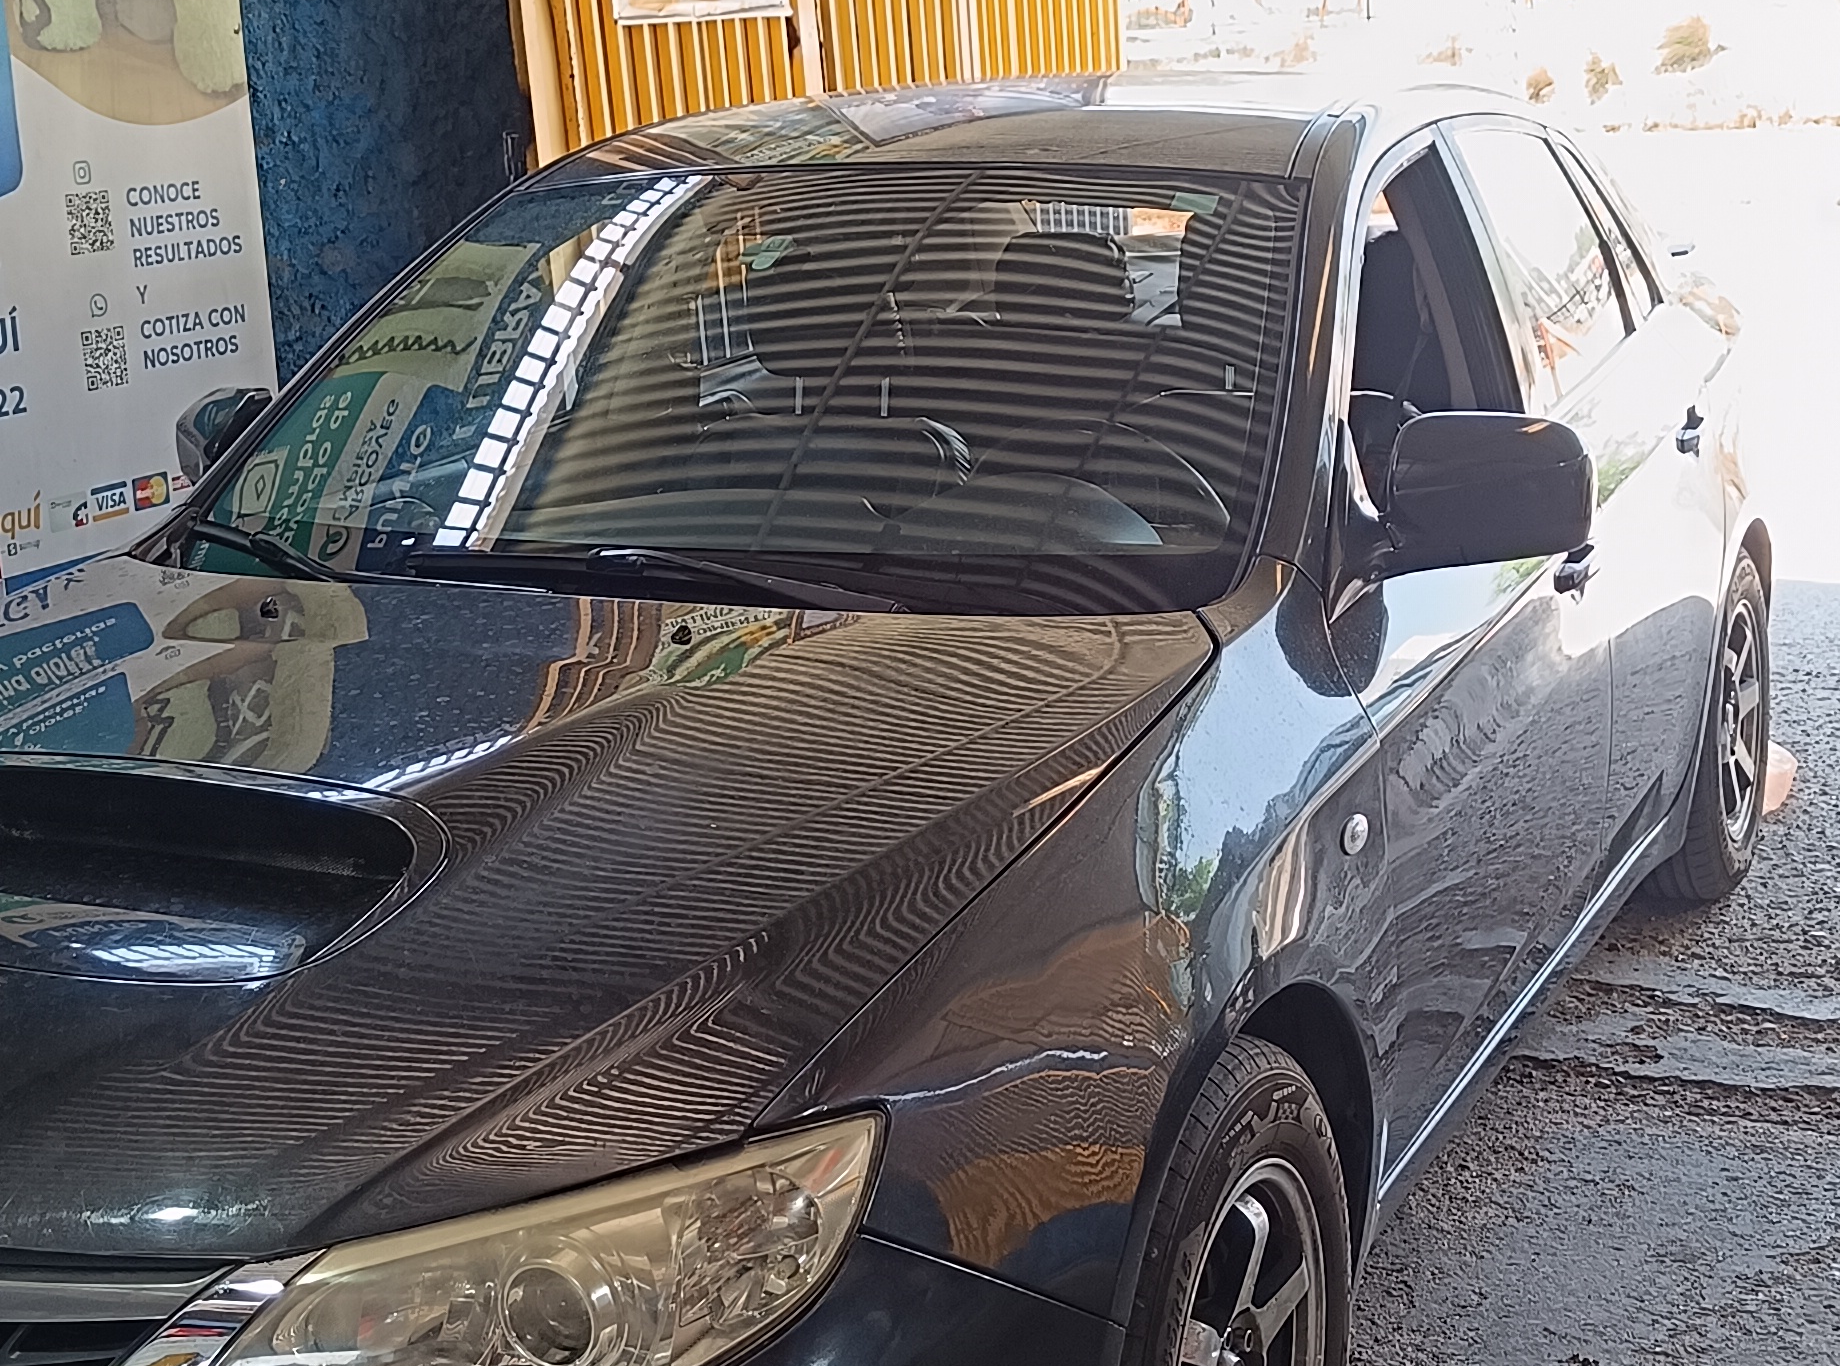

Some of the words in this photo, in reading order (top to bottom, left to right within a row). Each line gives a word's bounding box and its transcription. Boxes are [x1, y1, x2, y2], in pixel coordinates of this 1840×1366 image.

[126, 180, 201, 207] CONOCE
[129, 208, 220, 237] NUESTROS
[133, 235, 243, 268] RESULTADOS
[136, 285, 147, 304] Y
[140, 311, 204, 339] COTIZA
[208, 304, 246, 327] CON
[143, 335, 239, 369] NOSOTROS
[95, 491, 127, 512] VISA
